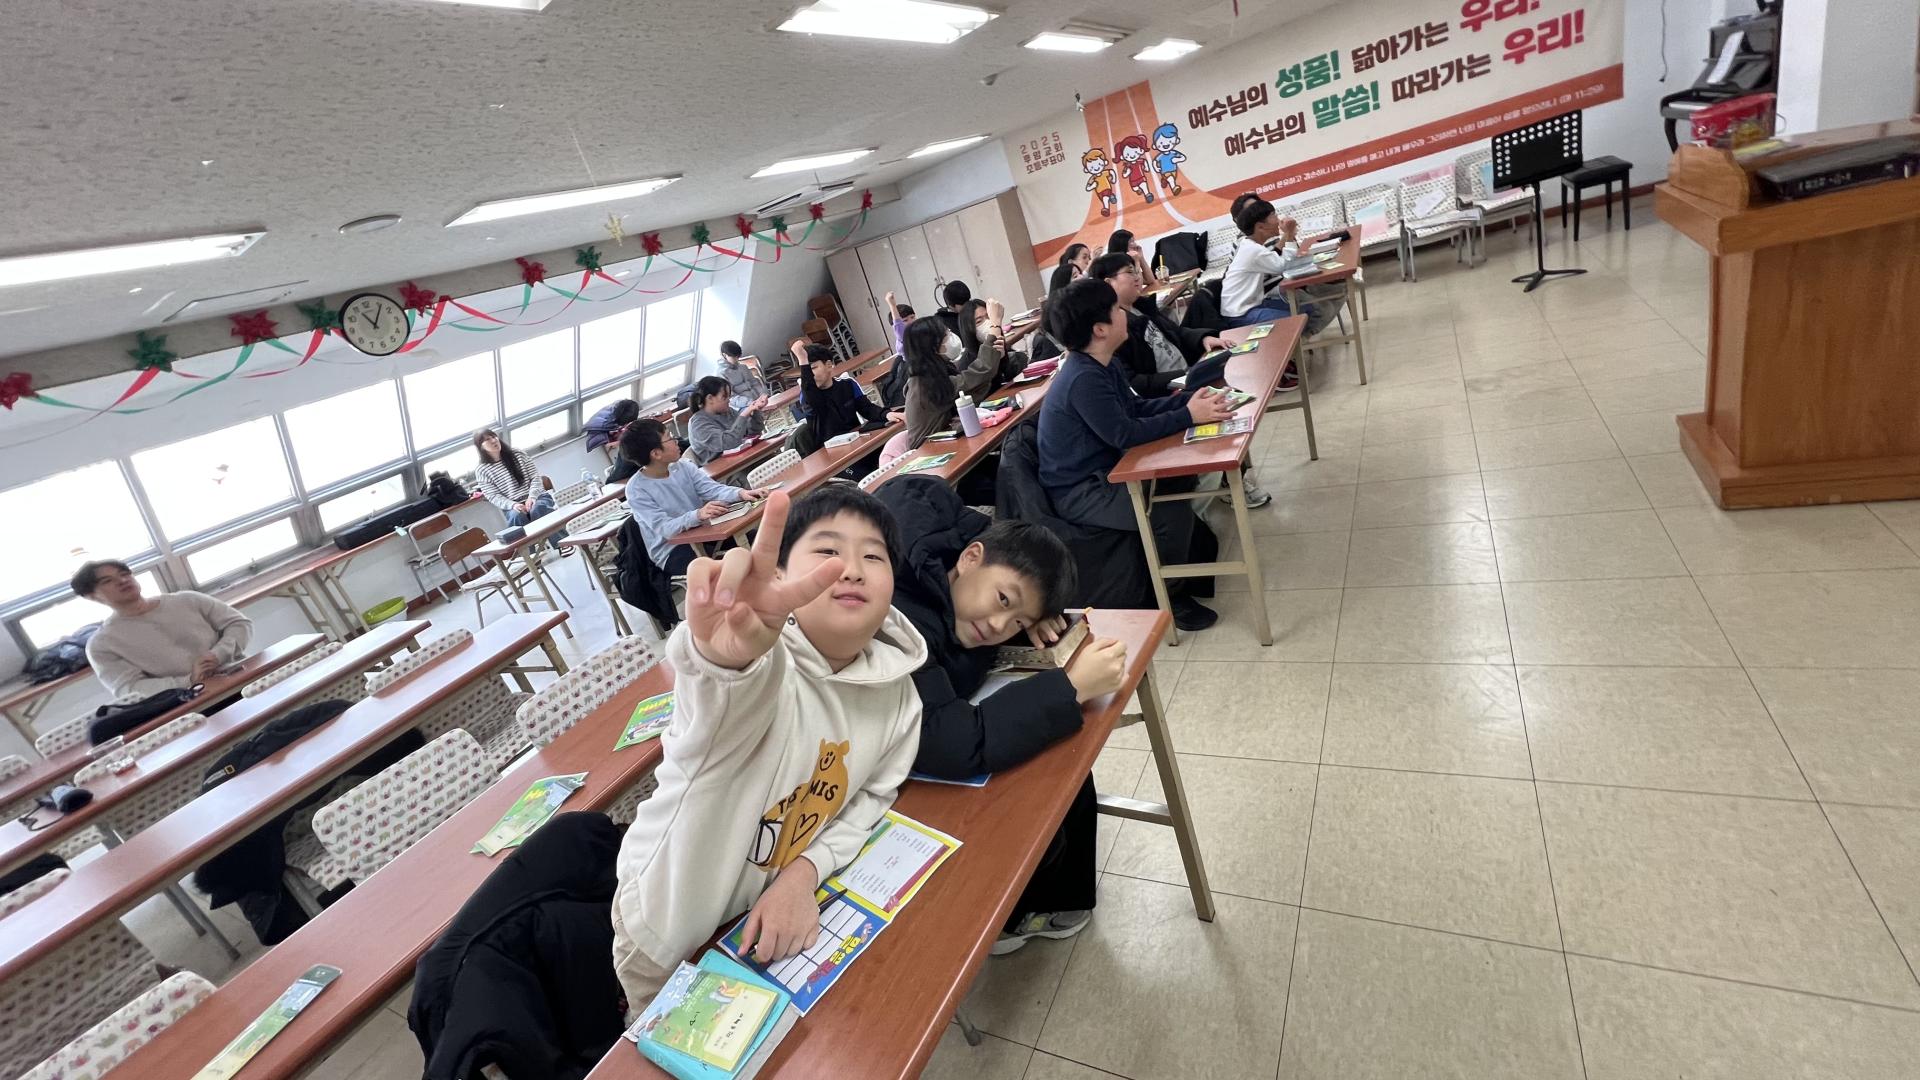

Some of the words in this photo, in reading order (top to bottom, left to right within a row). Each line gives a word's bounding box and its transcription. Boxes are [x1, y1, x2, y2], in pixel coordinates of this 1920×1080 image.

[1188, 83, 1268, 129] 예수님의
[1275, 49, 1341, 98] 성품!
[1351, 21, 1449, 74] 닮아가는
[1224, 112, 1306, 156] 예수님의
[1312, 80, 1380, 128] 말씀!
[1392, 53, 1491, 102] 따라가는
[1503, 9, 1584, 64] 우리!
